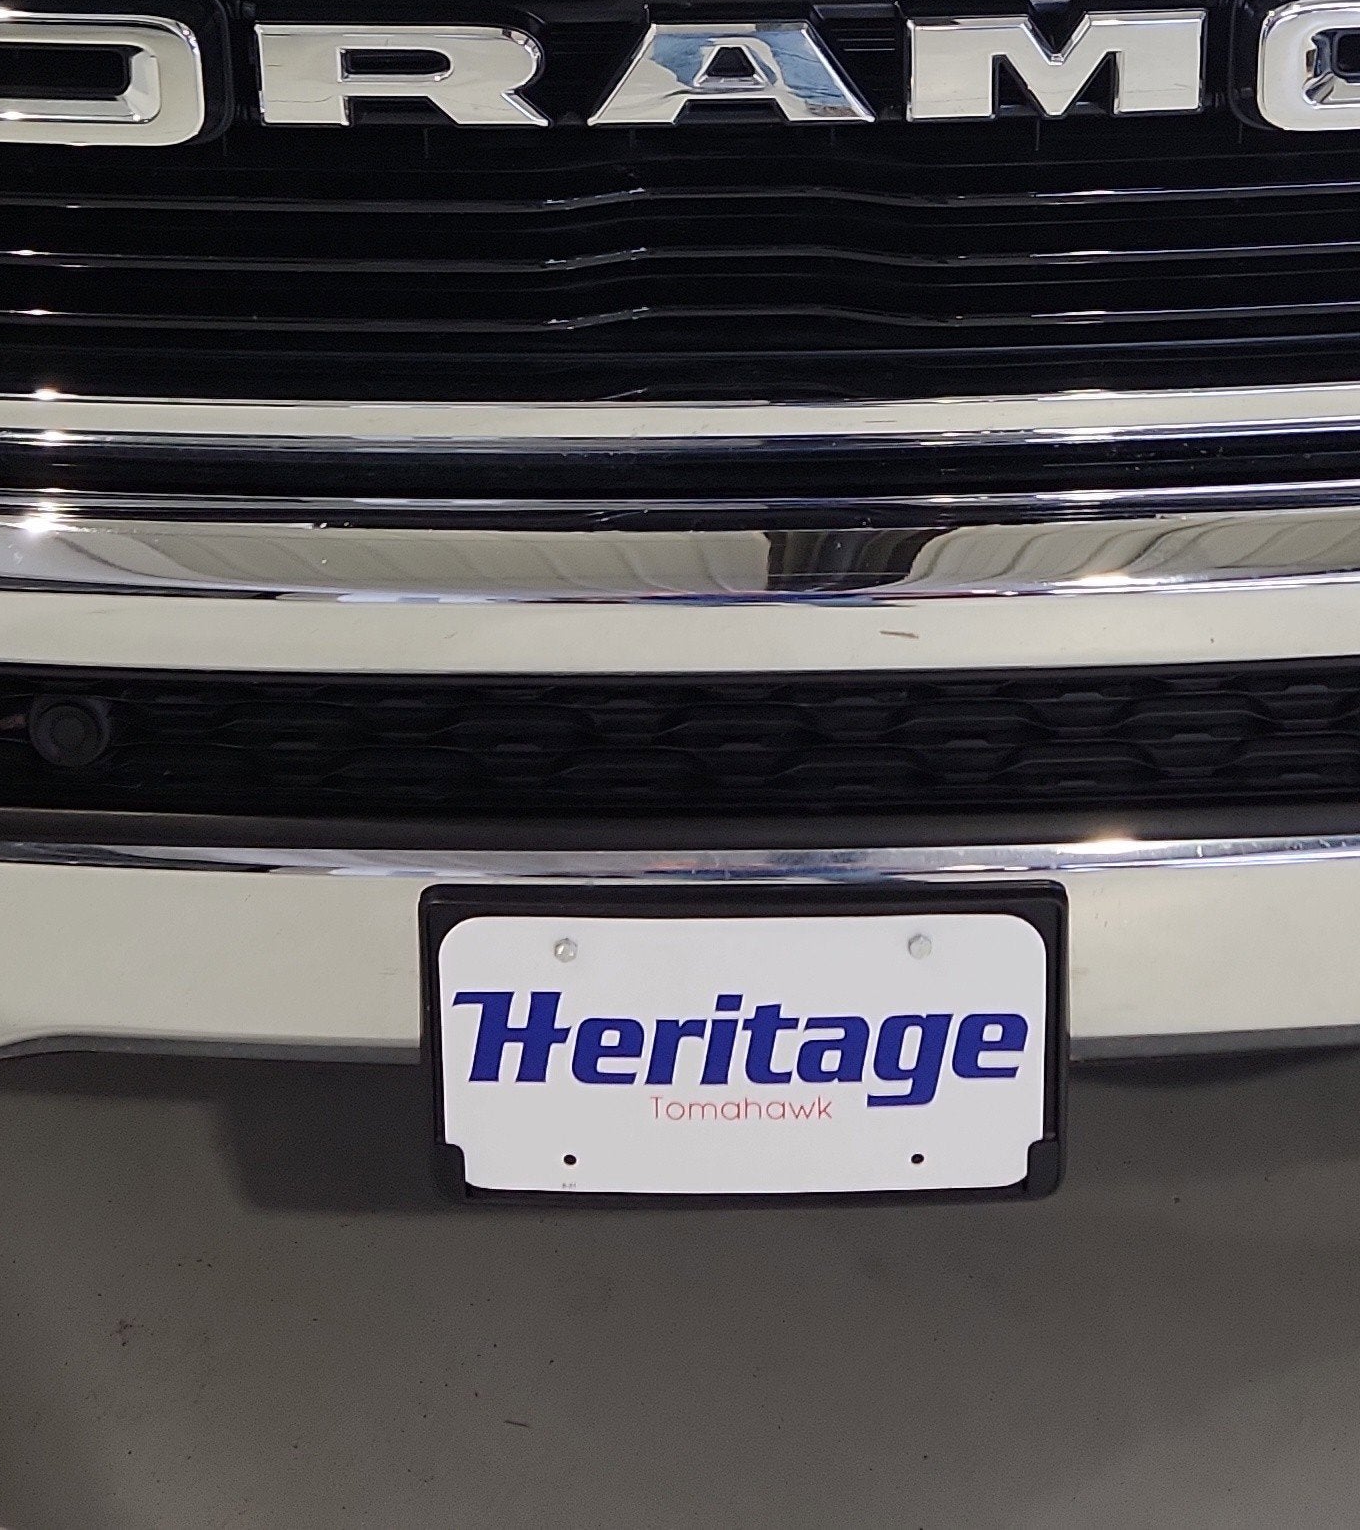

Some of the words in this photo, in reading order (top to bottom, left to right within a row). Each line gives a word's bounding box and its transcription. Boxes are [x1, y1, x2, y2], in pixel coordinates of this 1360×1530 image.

[253, 8, 1208, 127] RAM
[452, 990, 1030, 1108] Heritage
[650, 1095, 833, 1121] Tomahawk
